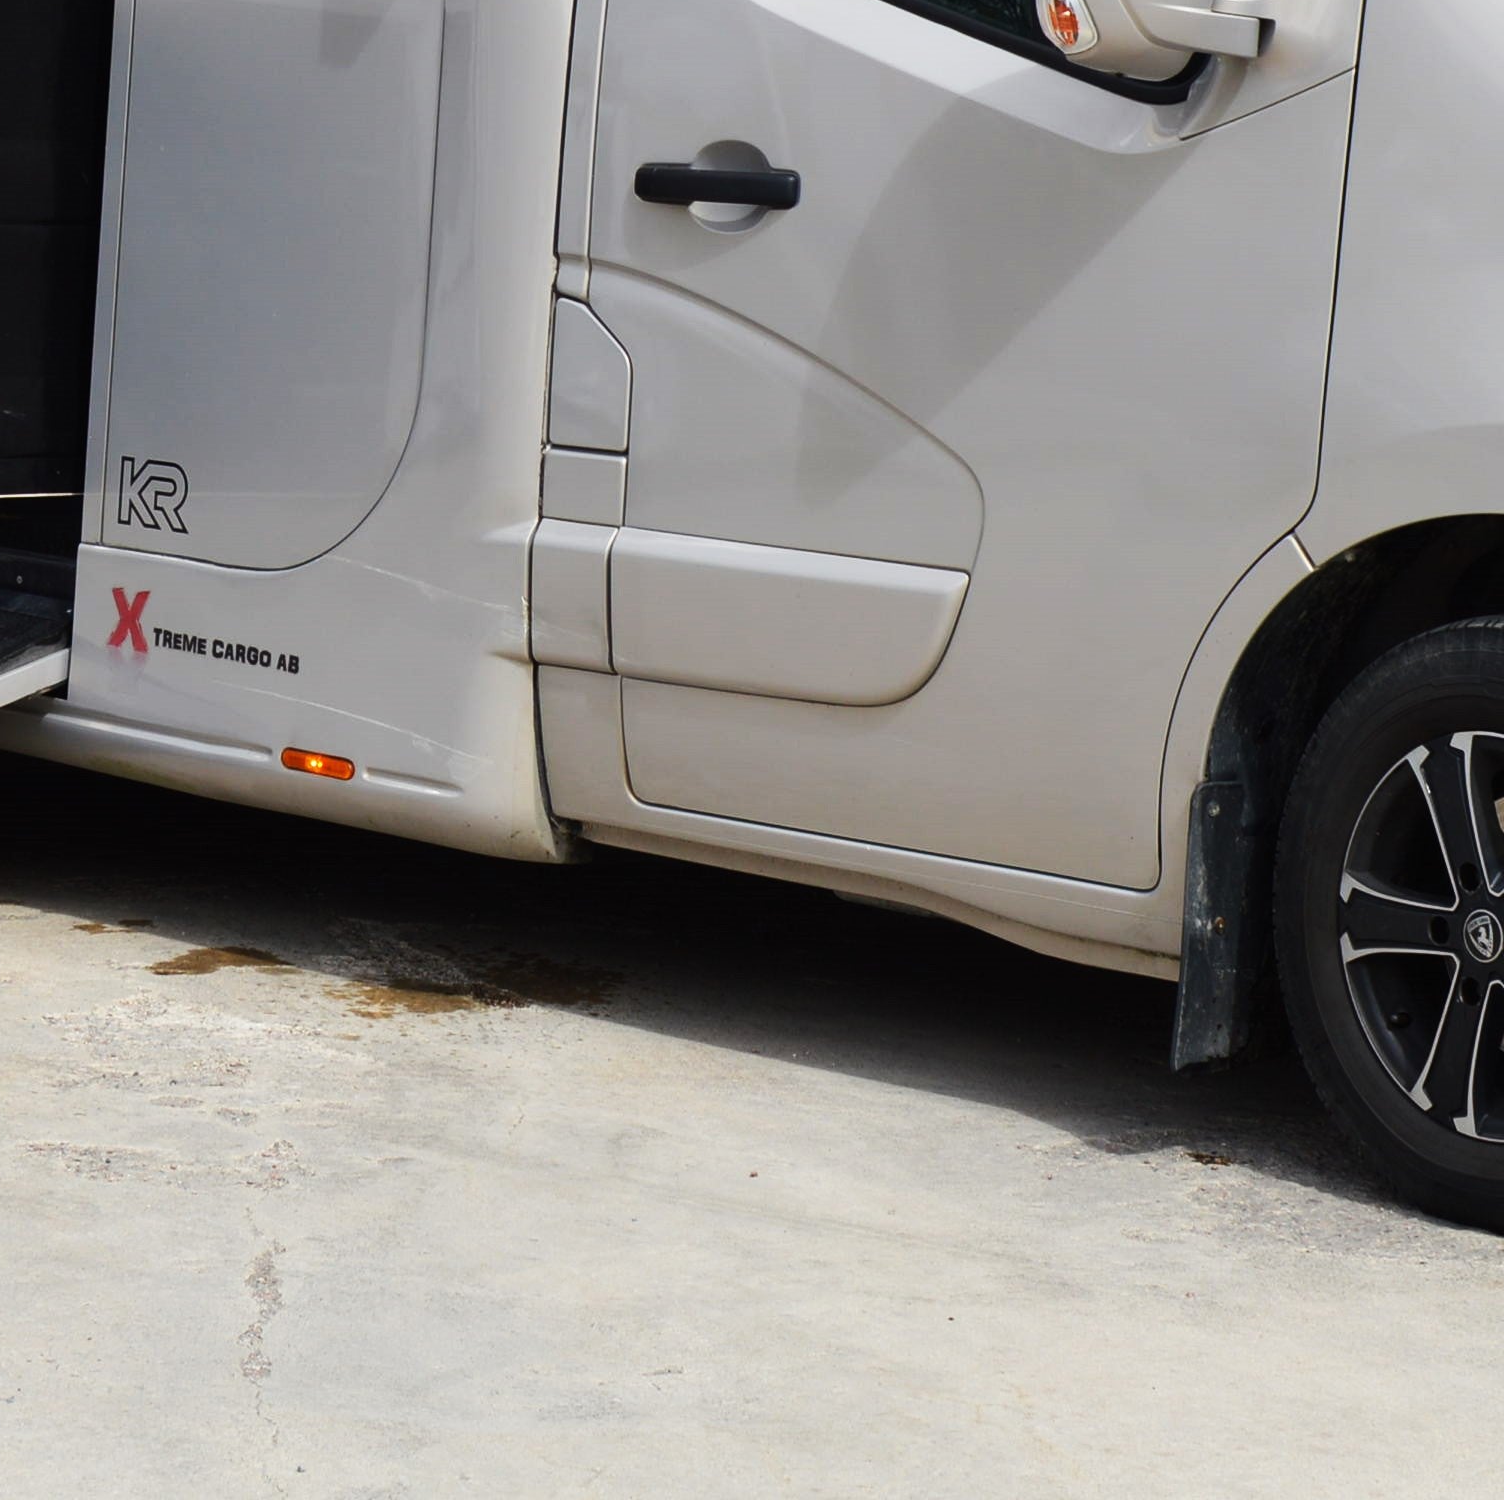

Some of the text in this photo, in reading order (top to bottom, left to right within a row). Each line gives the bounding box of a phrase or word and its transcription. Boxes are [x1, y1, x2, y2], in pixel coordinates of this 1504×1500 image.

[117, 456, 189, 534] KR
[211, 639, 272, 668] CARGO
[276, 654, 300, 675] AB
